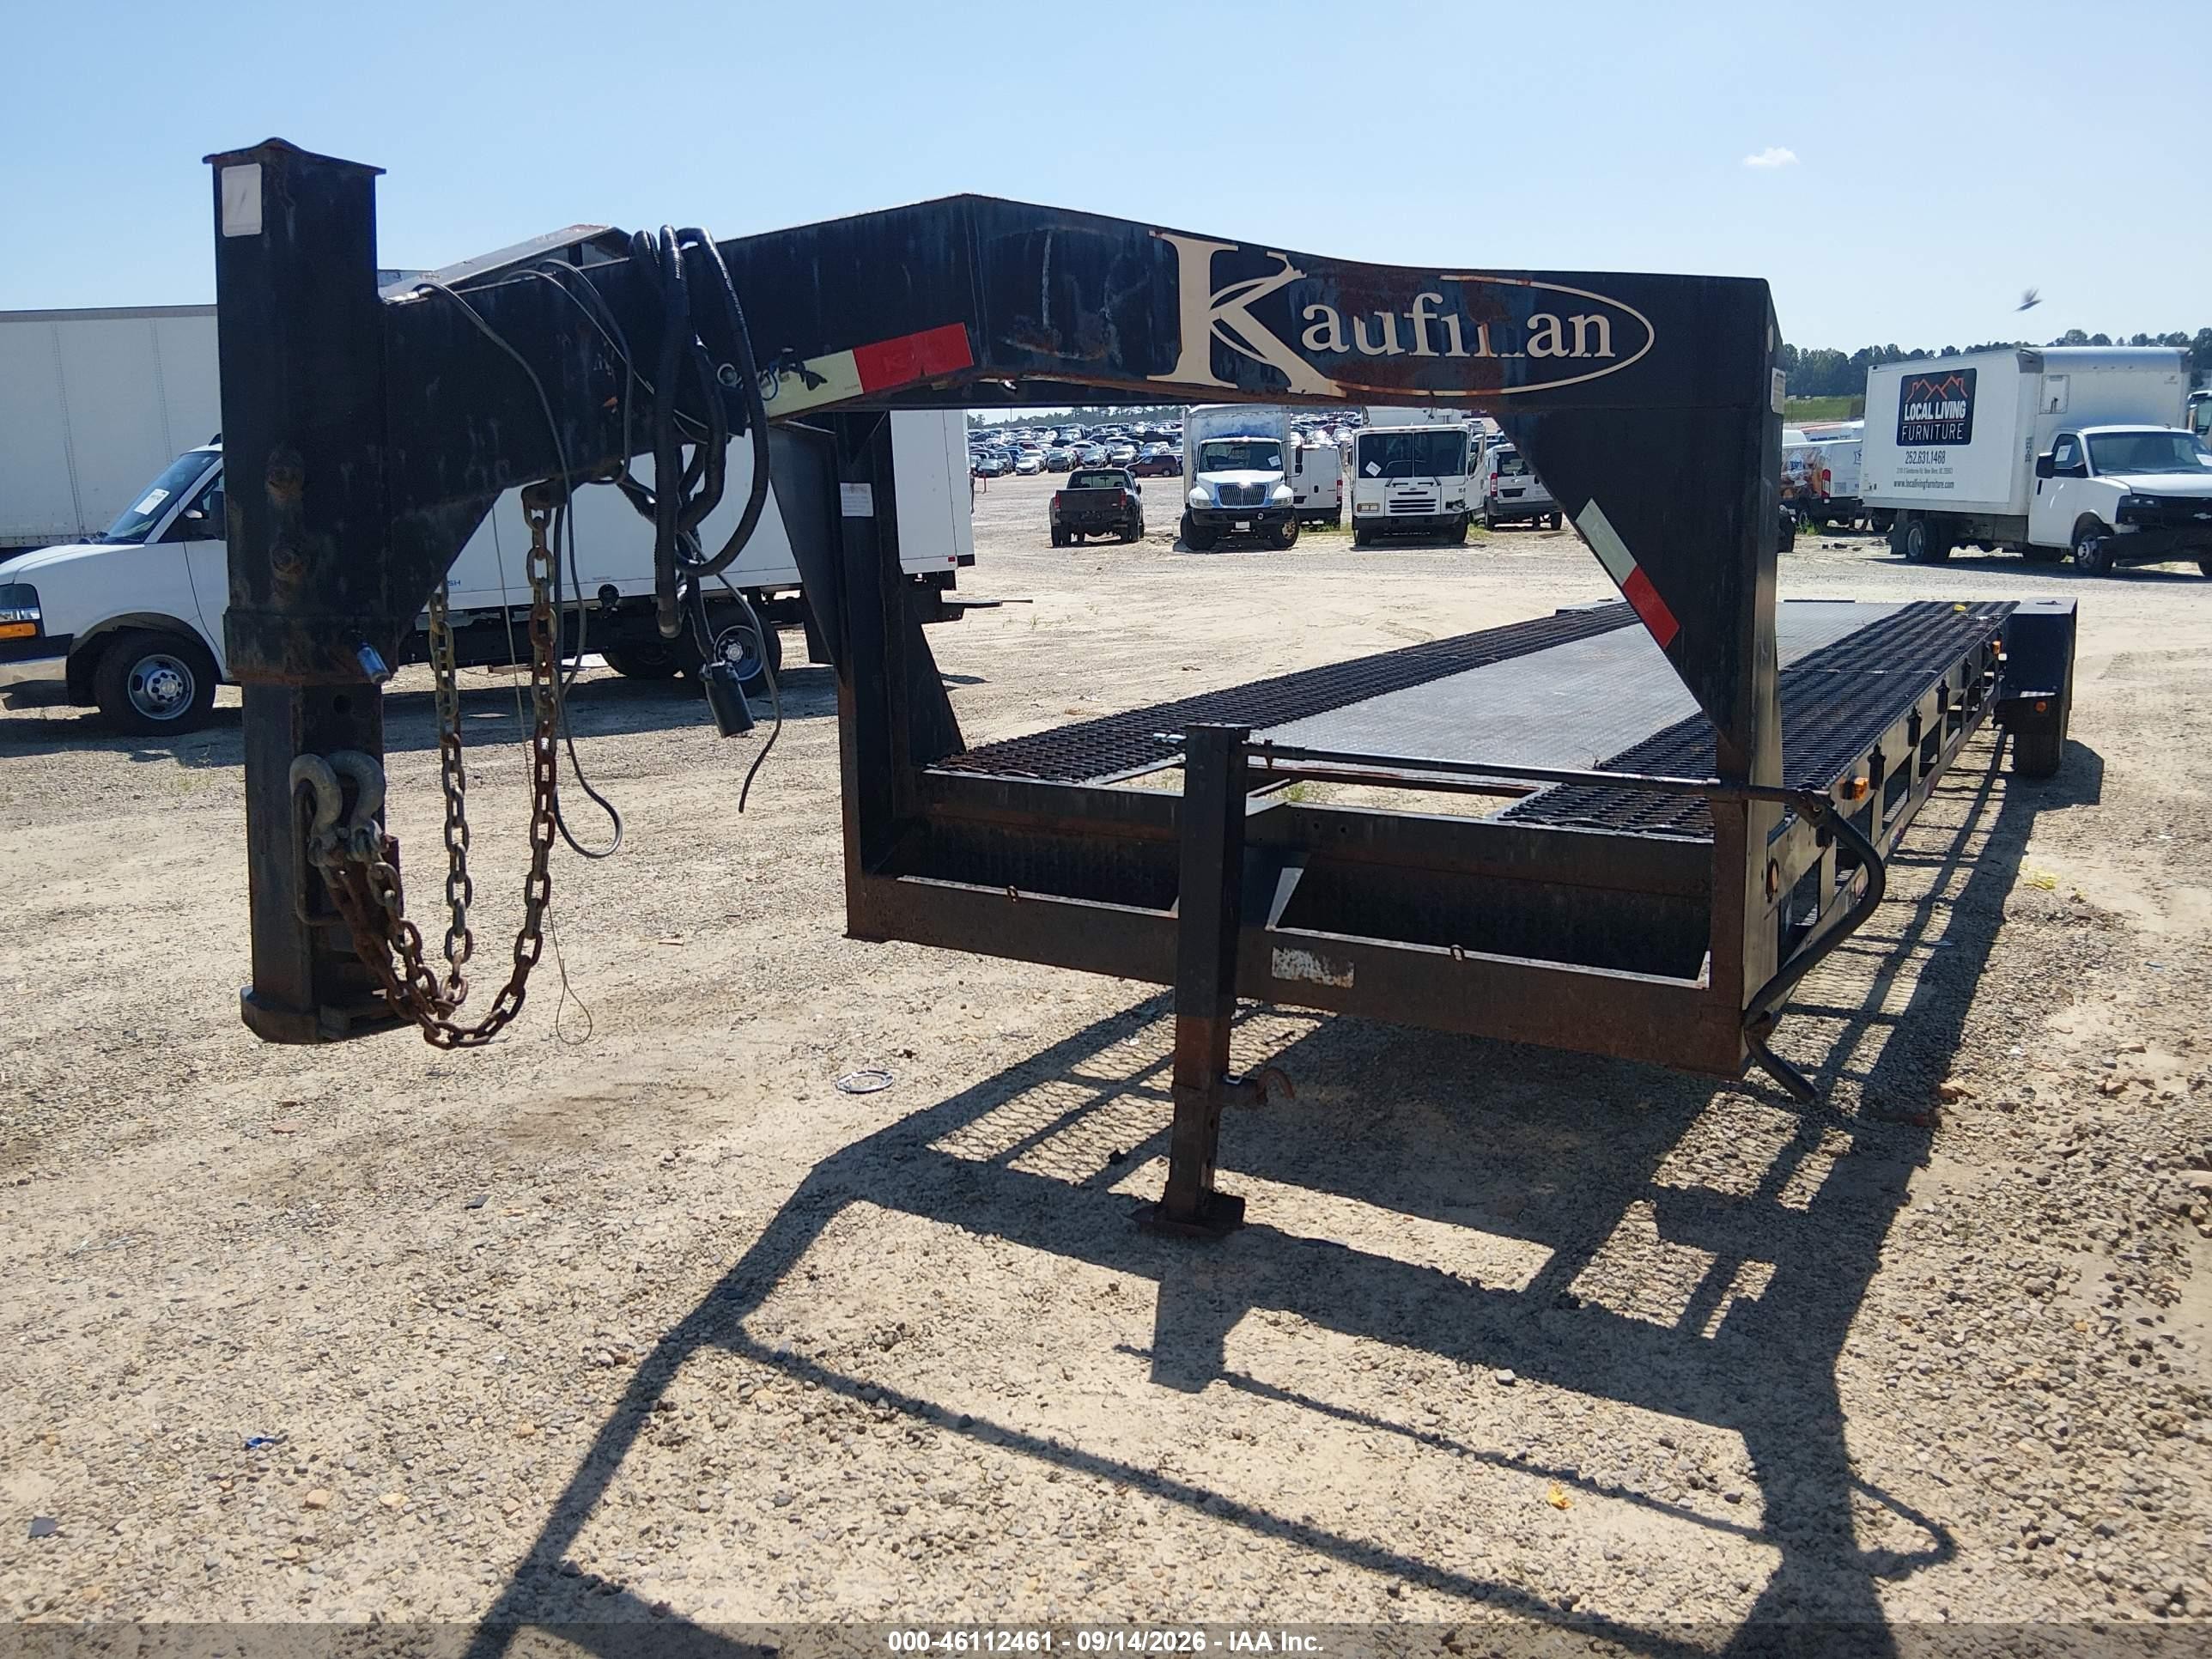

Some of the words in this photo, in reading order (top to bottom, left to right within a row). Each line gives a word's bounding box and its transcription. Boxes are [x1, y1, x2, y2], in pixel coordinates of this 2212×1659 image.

[1904, 402, 1934, 421] LOCAL
[1935, 400, 1966, 420] LIVING
[1901, 422, 1965, 441] FURNITURE
[1905, 450, 1946, 465] 252.631.1468
